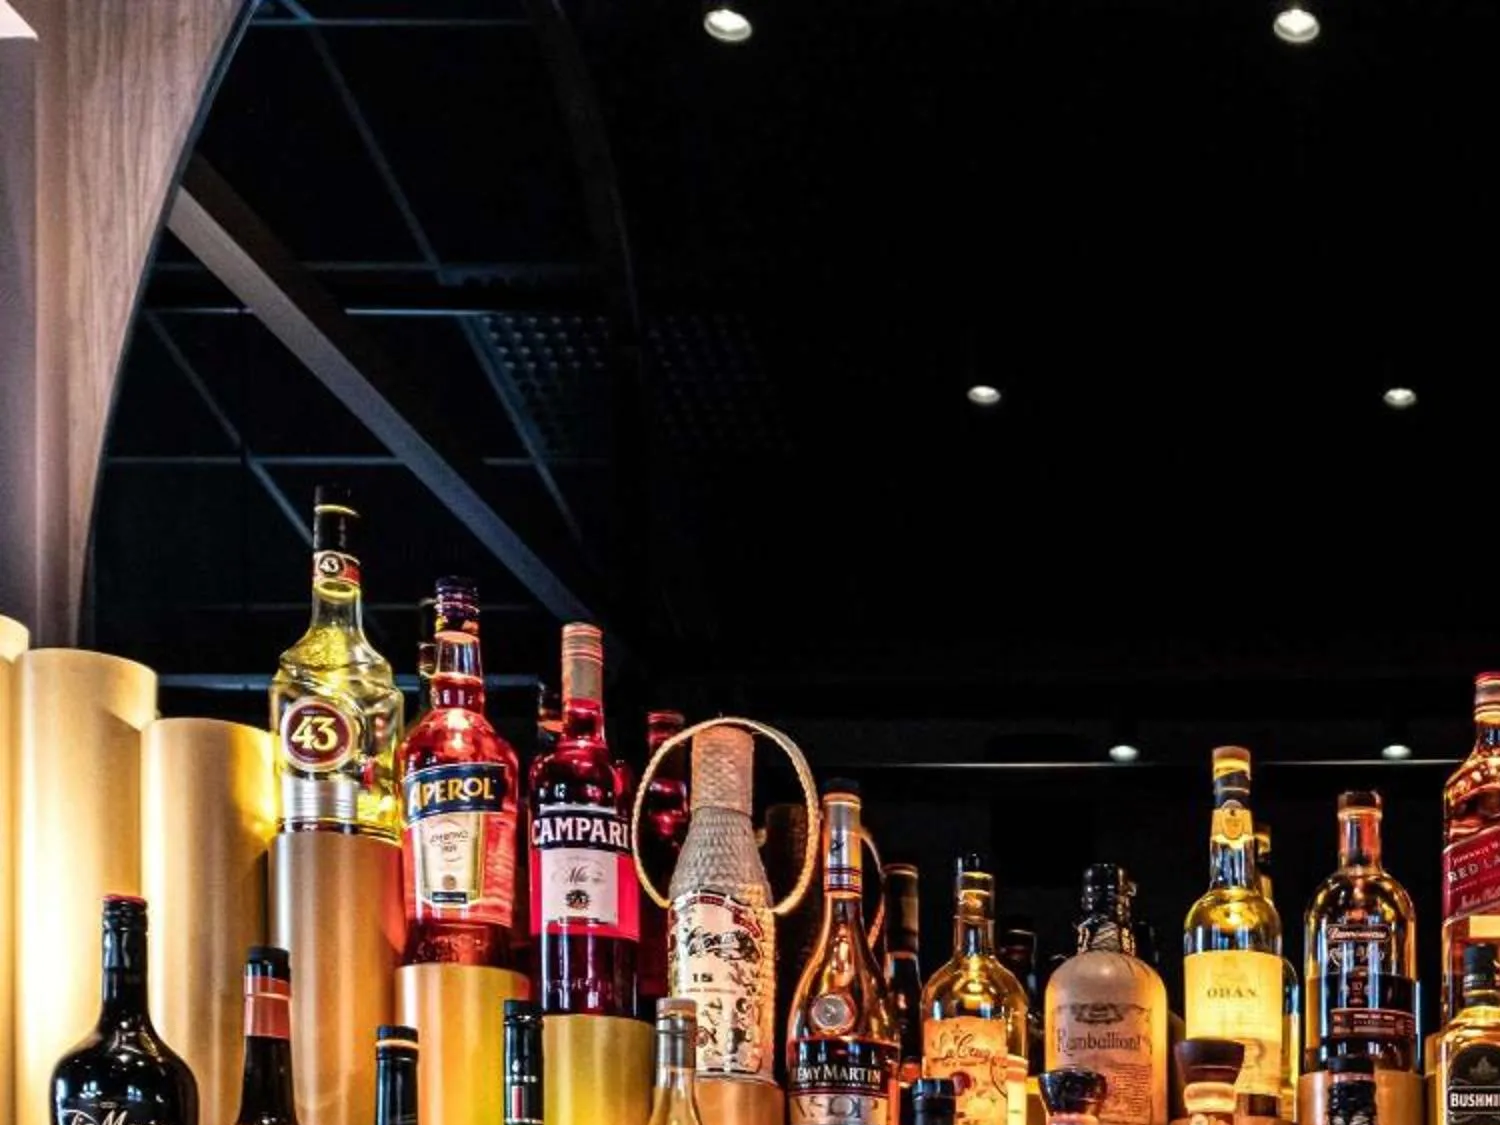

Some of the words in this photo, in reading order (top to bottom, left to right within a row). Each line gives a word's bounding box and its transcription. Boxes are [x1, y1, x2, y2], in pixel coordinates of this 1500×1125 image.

[319, 558, 340, 573] 43
[291, 716, 338, 752] 43
[408, 777, 496, 813] APEROL
[532, 816, 629, 848] CAMPARI
[1448, 863, 1480, 883] RED
[1206, 987, 1259, 998] OBAN
[823, 1063, 881, 1083] MARTIN
